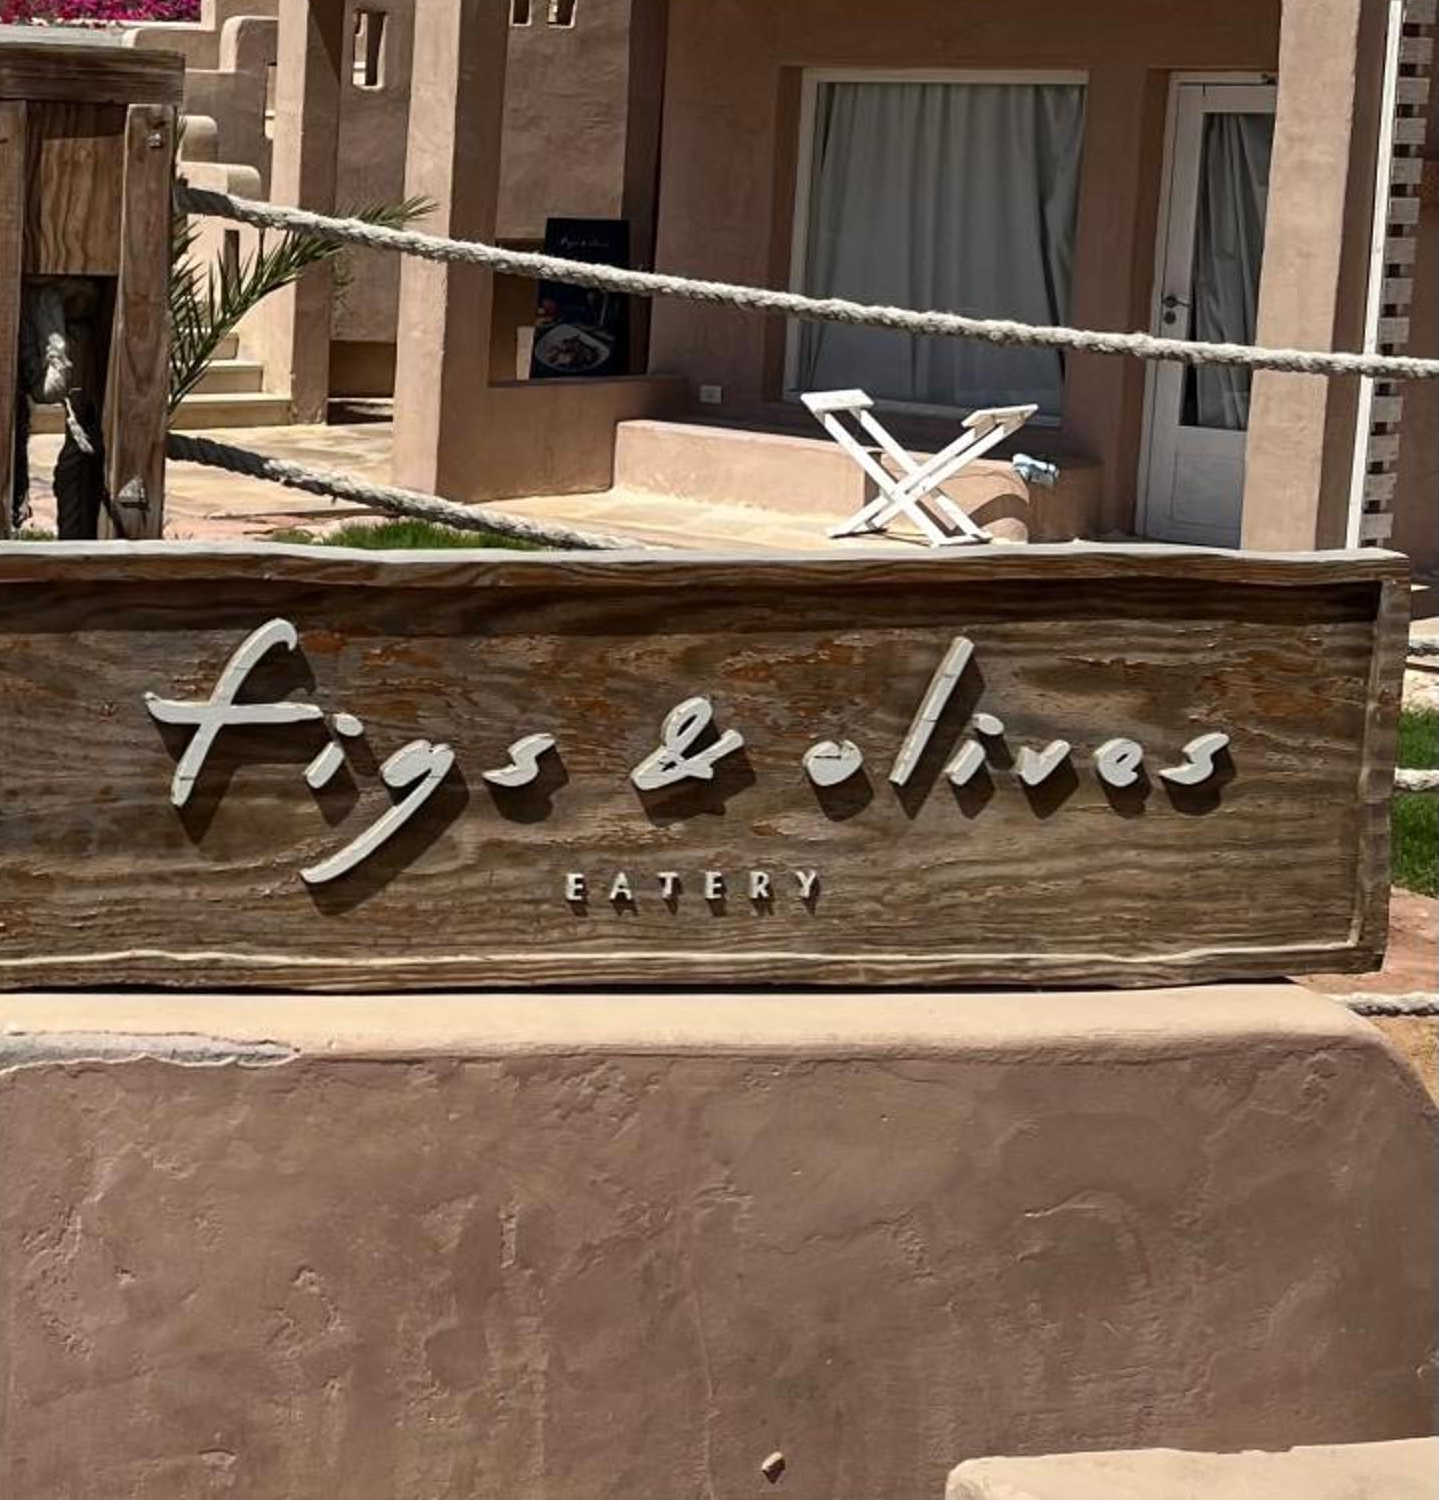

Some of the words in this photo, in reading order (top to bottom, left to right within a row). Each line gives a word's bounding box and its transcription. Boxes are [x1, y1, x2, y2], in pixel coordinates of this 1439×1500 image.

[144, 617, 557, 884] figs
[630, 696, 745, 791] &
[803, 635, 1230, 788] olives
[565, 870, 818, 901] EATERY
